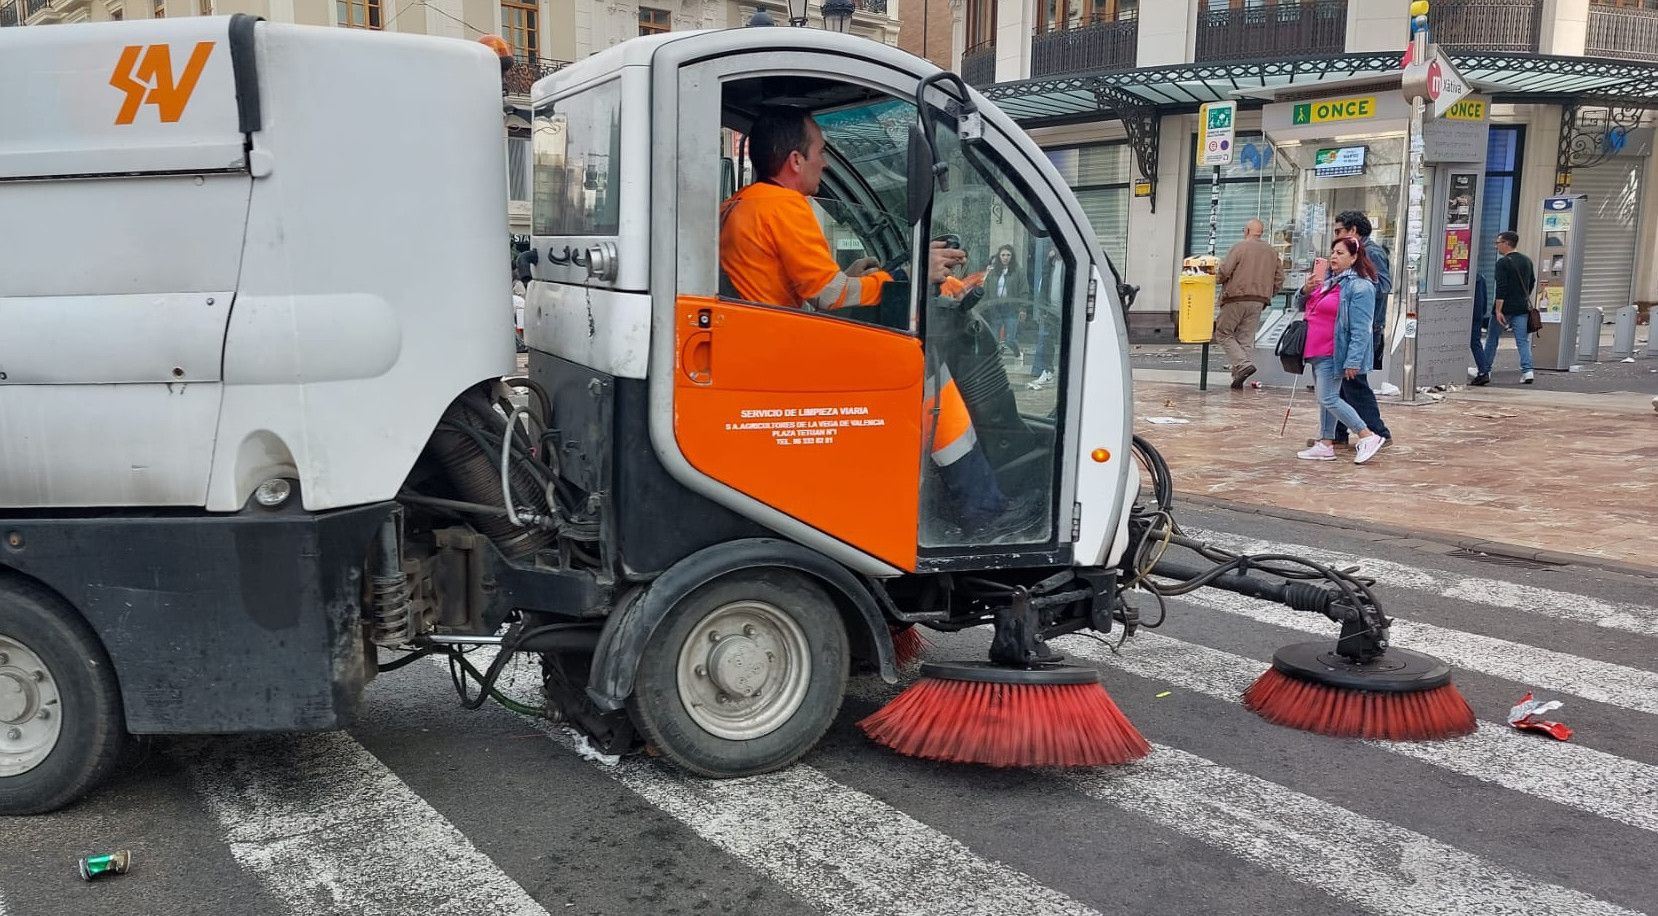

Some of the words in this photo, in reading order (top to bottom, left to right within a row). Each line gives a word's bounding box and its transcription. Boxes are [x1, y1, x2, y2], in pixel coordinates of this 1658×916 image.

[1317, 100, 1369, 118] ONCE
[1451, 102, 1482, 117] ONCE
[741, 409, 783, 418] SERVICIO
[784, 409, 796, 417] DE
[798, 408, 838, 417] LIMPIEZA
[840, 407, 868, 415] VIARIA
